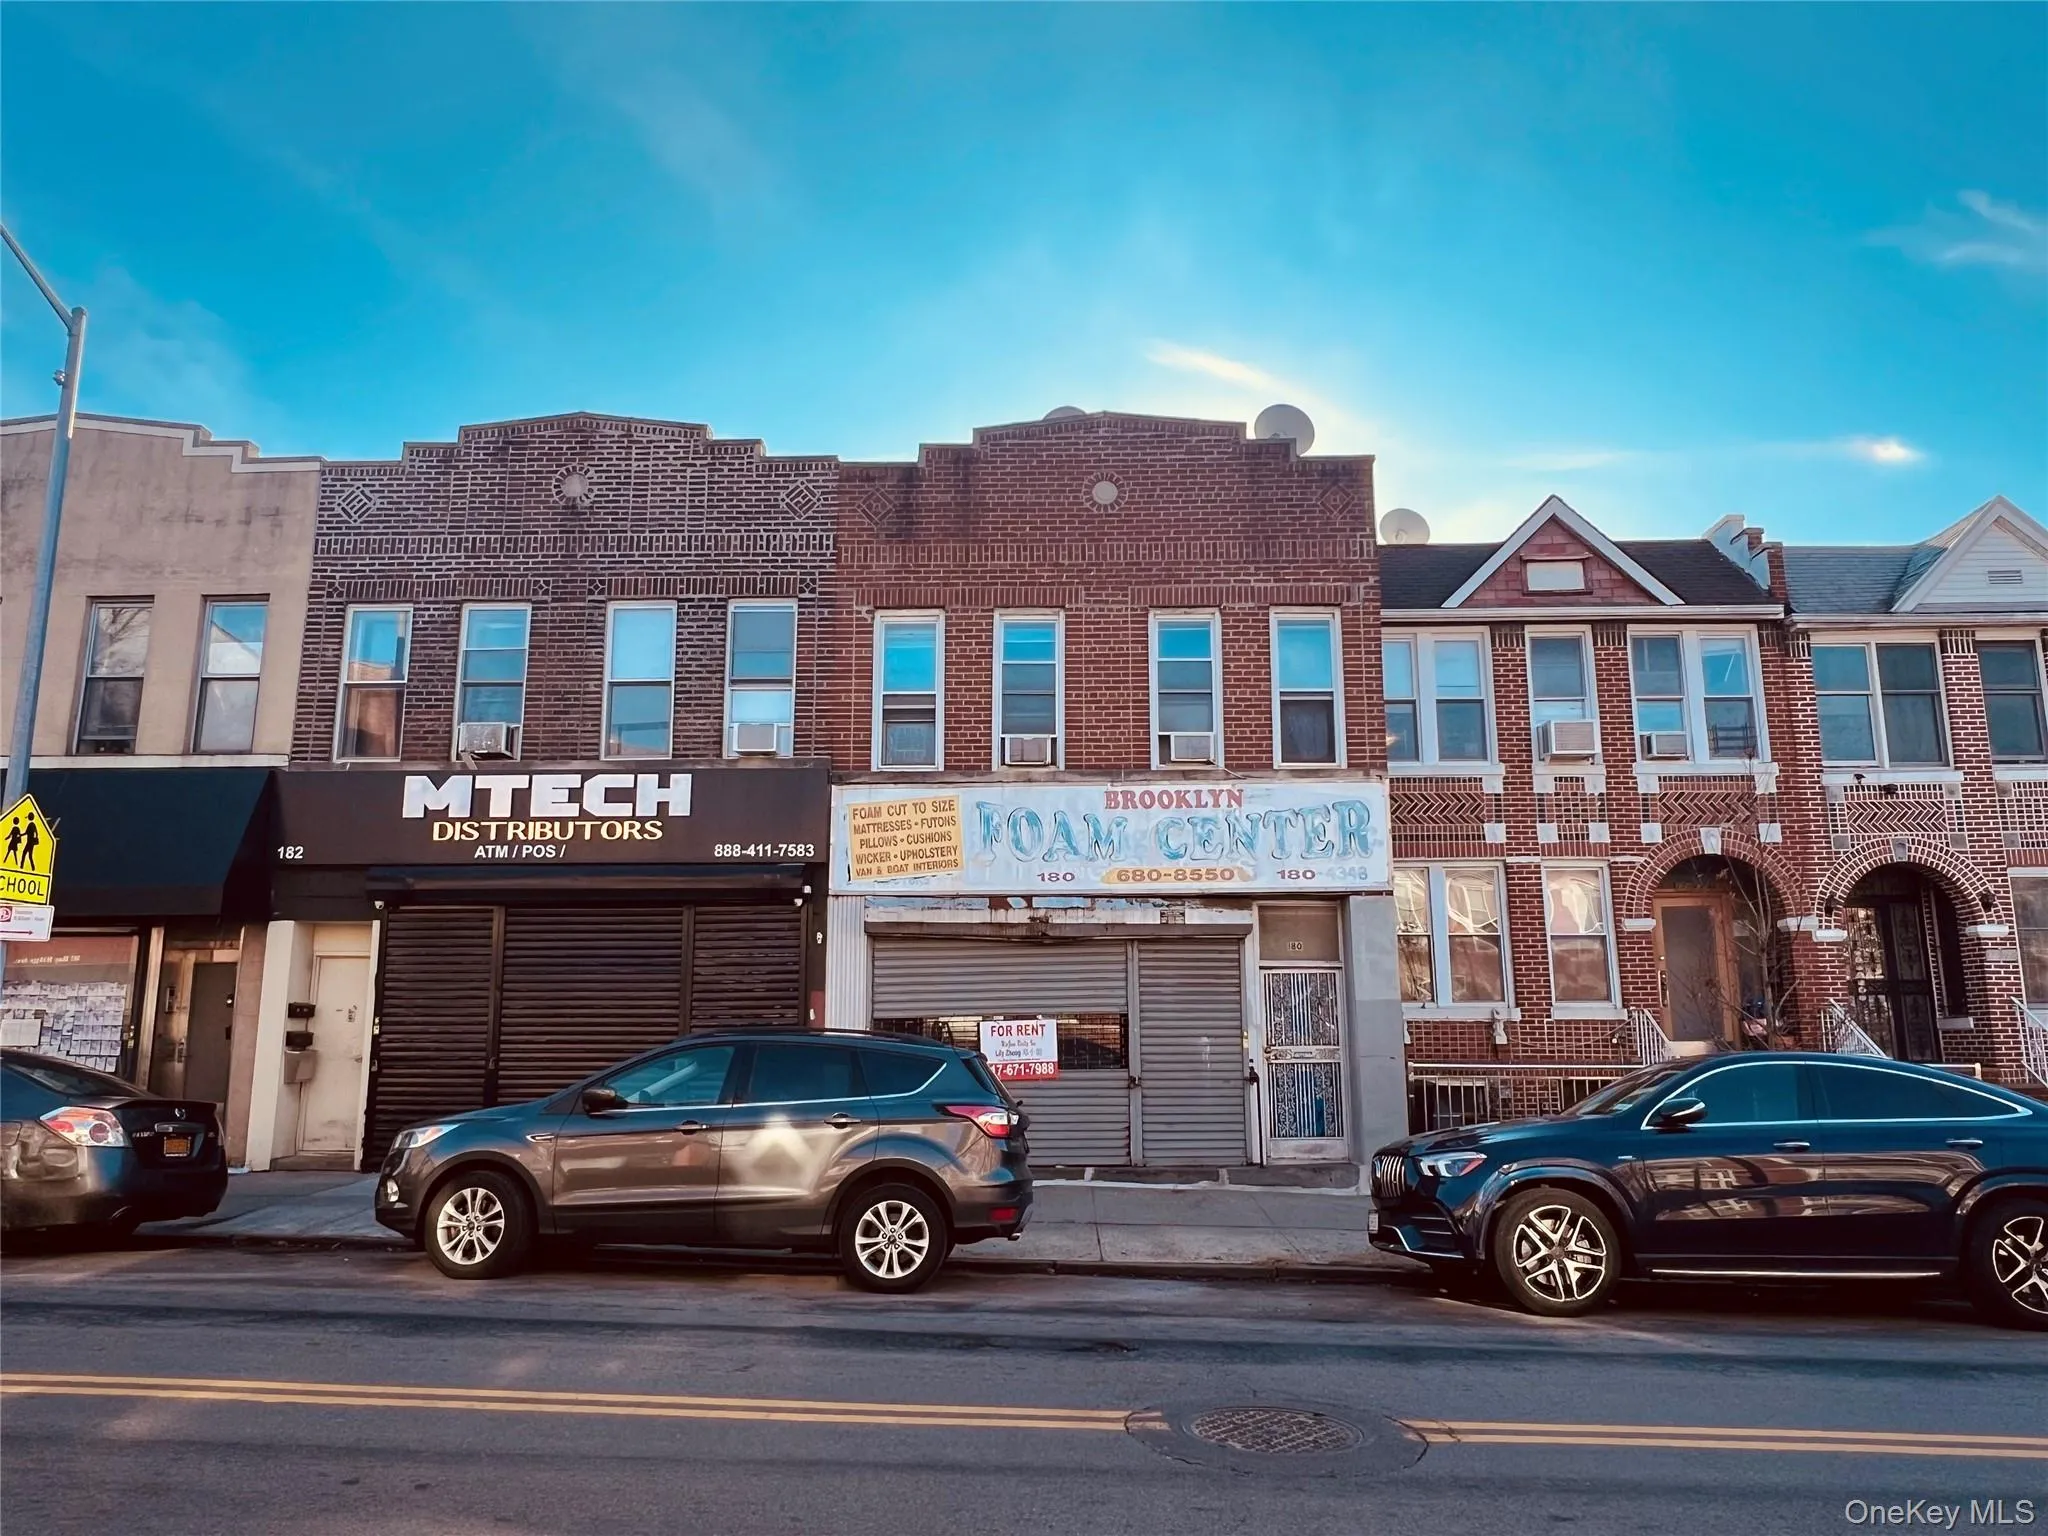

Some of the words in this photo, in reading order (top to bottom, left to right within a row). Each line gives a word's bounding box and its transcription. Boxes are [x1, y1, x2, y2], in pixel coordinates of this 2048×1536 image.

[402, 773, 692, 818] MTECH
[1104, 789, 1244, 809] BROOKLYN
[852, 806, 882, 820] FOAM
[887, 804, 907, 816] CUT
[912, 802, 926, 814] TO
[931, 799, 955, 813] SIZE
[432, 820, 663, 841] DISTRIBUTORS
[853, 819, 912, 835] MATTRESSES
[921, 816, 956, 829] FUTONS
[972, 801, 1128, 866] FOAM
[1156, 799, 1372, 861] CENTER
[859, 835, 898, 849] PILLOWS
[906, 831, 952, 845] CUSHIONS
[277, 846, 304, 859] 182
[474, 845, 509, 859] ATM
[522, 844, 556, 859] POS
[714, 843, 815, 857] 888-411-7583
[856, 851, 891, 865] WICKER
[900, 845, 958, 861] UPHOLSTERY
[856, 867, 872, 877] VAN
[887, 864, 909, 874] BOAT
[913, 858, 959, 871] INTERIORS
[1116, 868, 1235, 882] 680-8550
[1276, 869, 1316, 880] 180
[0, 875, 45, 896] CHOOL
[1036, 872, 1075, 882] 180
[990, 1025, 1013, 1037] FOR
[1016, 1024, 1046, 1037] RENT
[991, 1062, 1055, 1076] 17-671-7988
